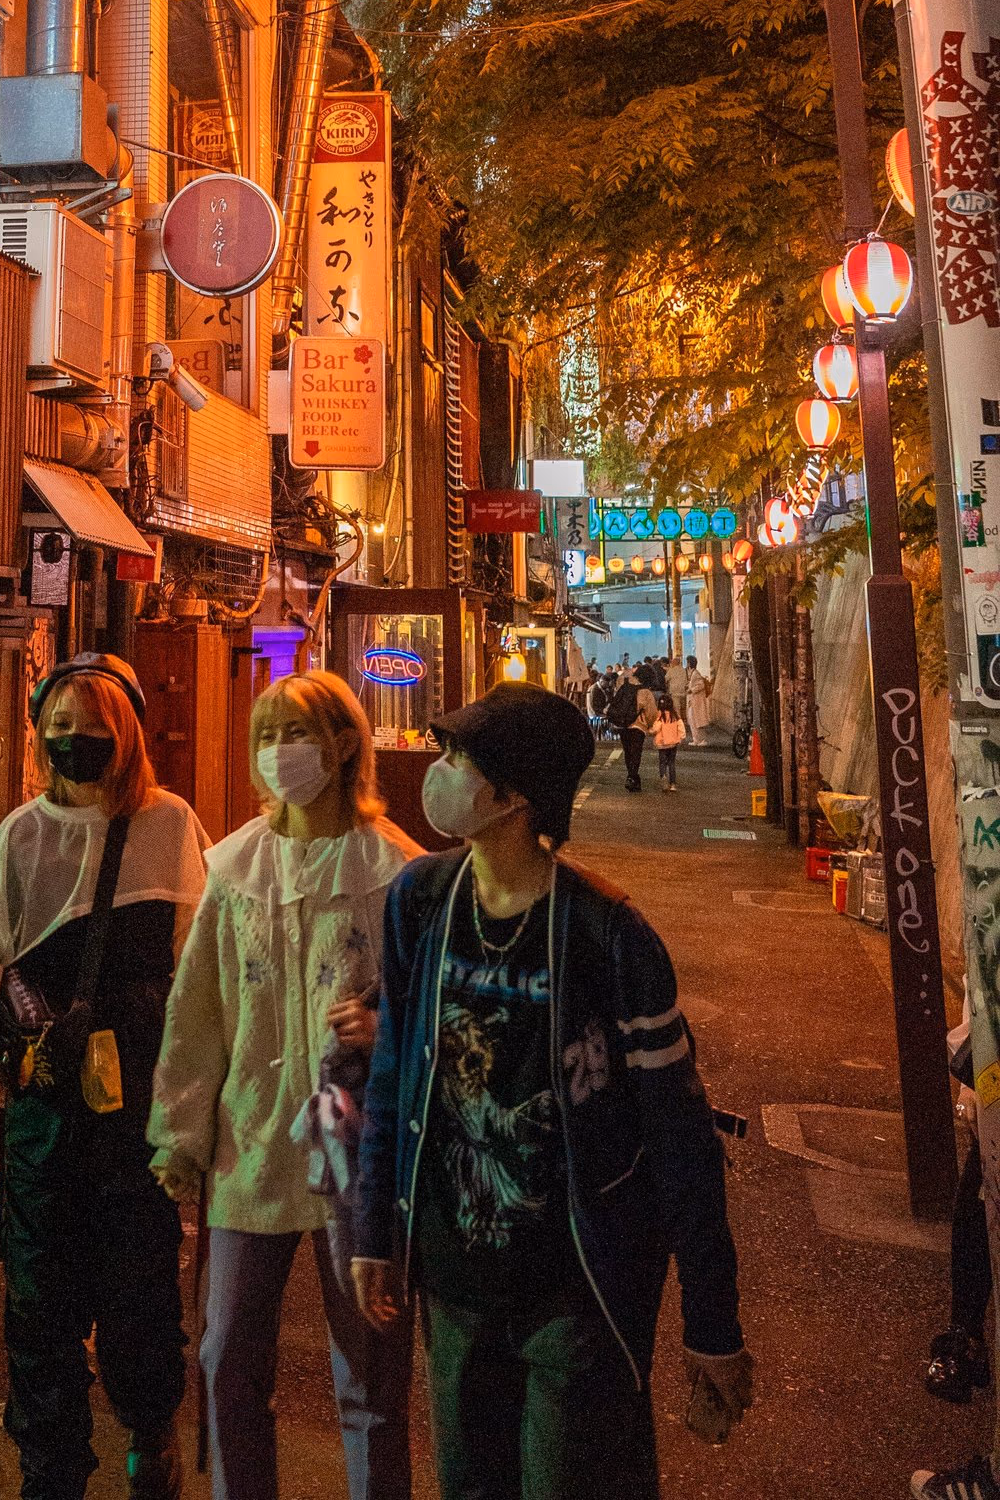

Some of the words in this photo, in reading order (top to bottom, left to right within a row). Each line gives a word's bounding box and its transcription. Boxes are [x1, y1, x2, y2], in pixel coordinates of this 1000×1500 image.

[326, 128, 365, 139] KIRIN
[359, 170, 376, 248] やきとり
[302, 349, 349, 370] Bar
[302, 373, 377, 393] Sakura
[302, 398, 370, 410] WHISKEY
[302, 411, 342, 422] FOOD
[302, 425, 339, 436] BEER
[341, 427, 360, 437] etc
